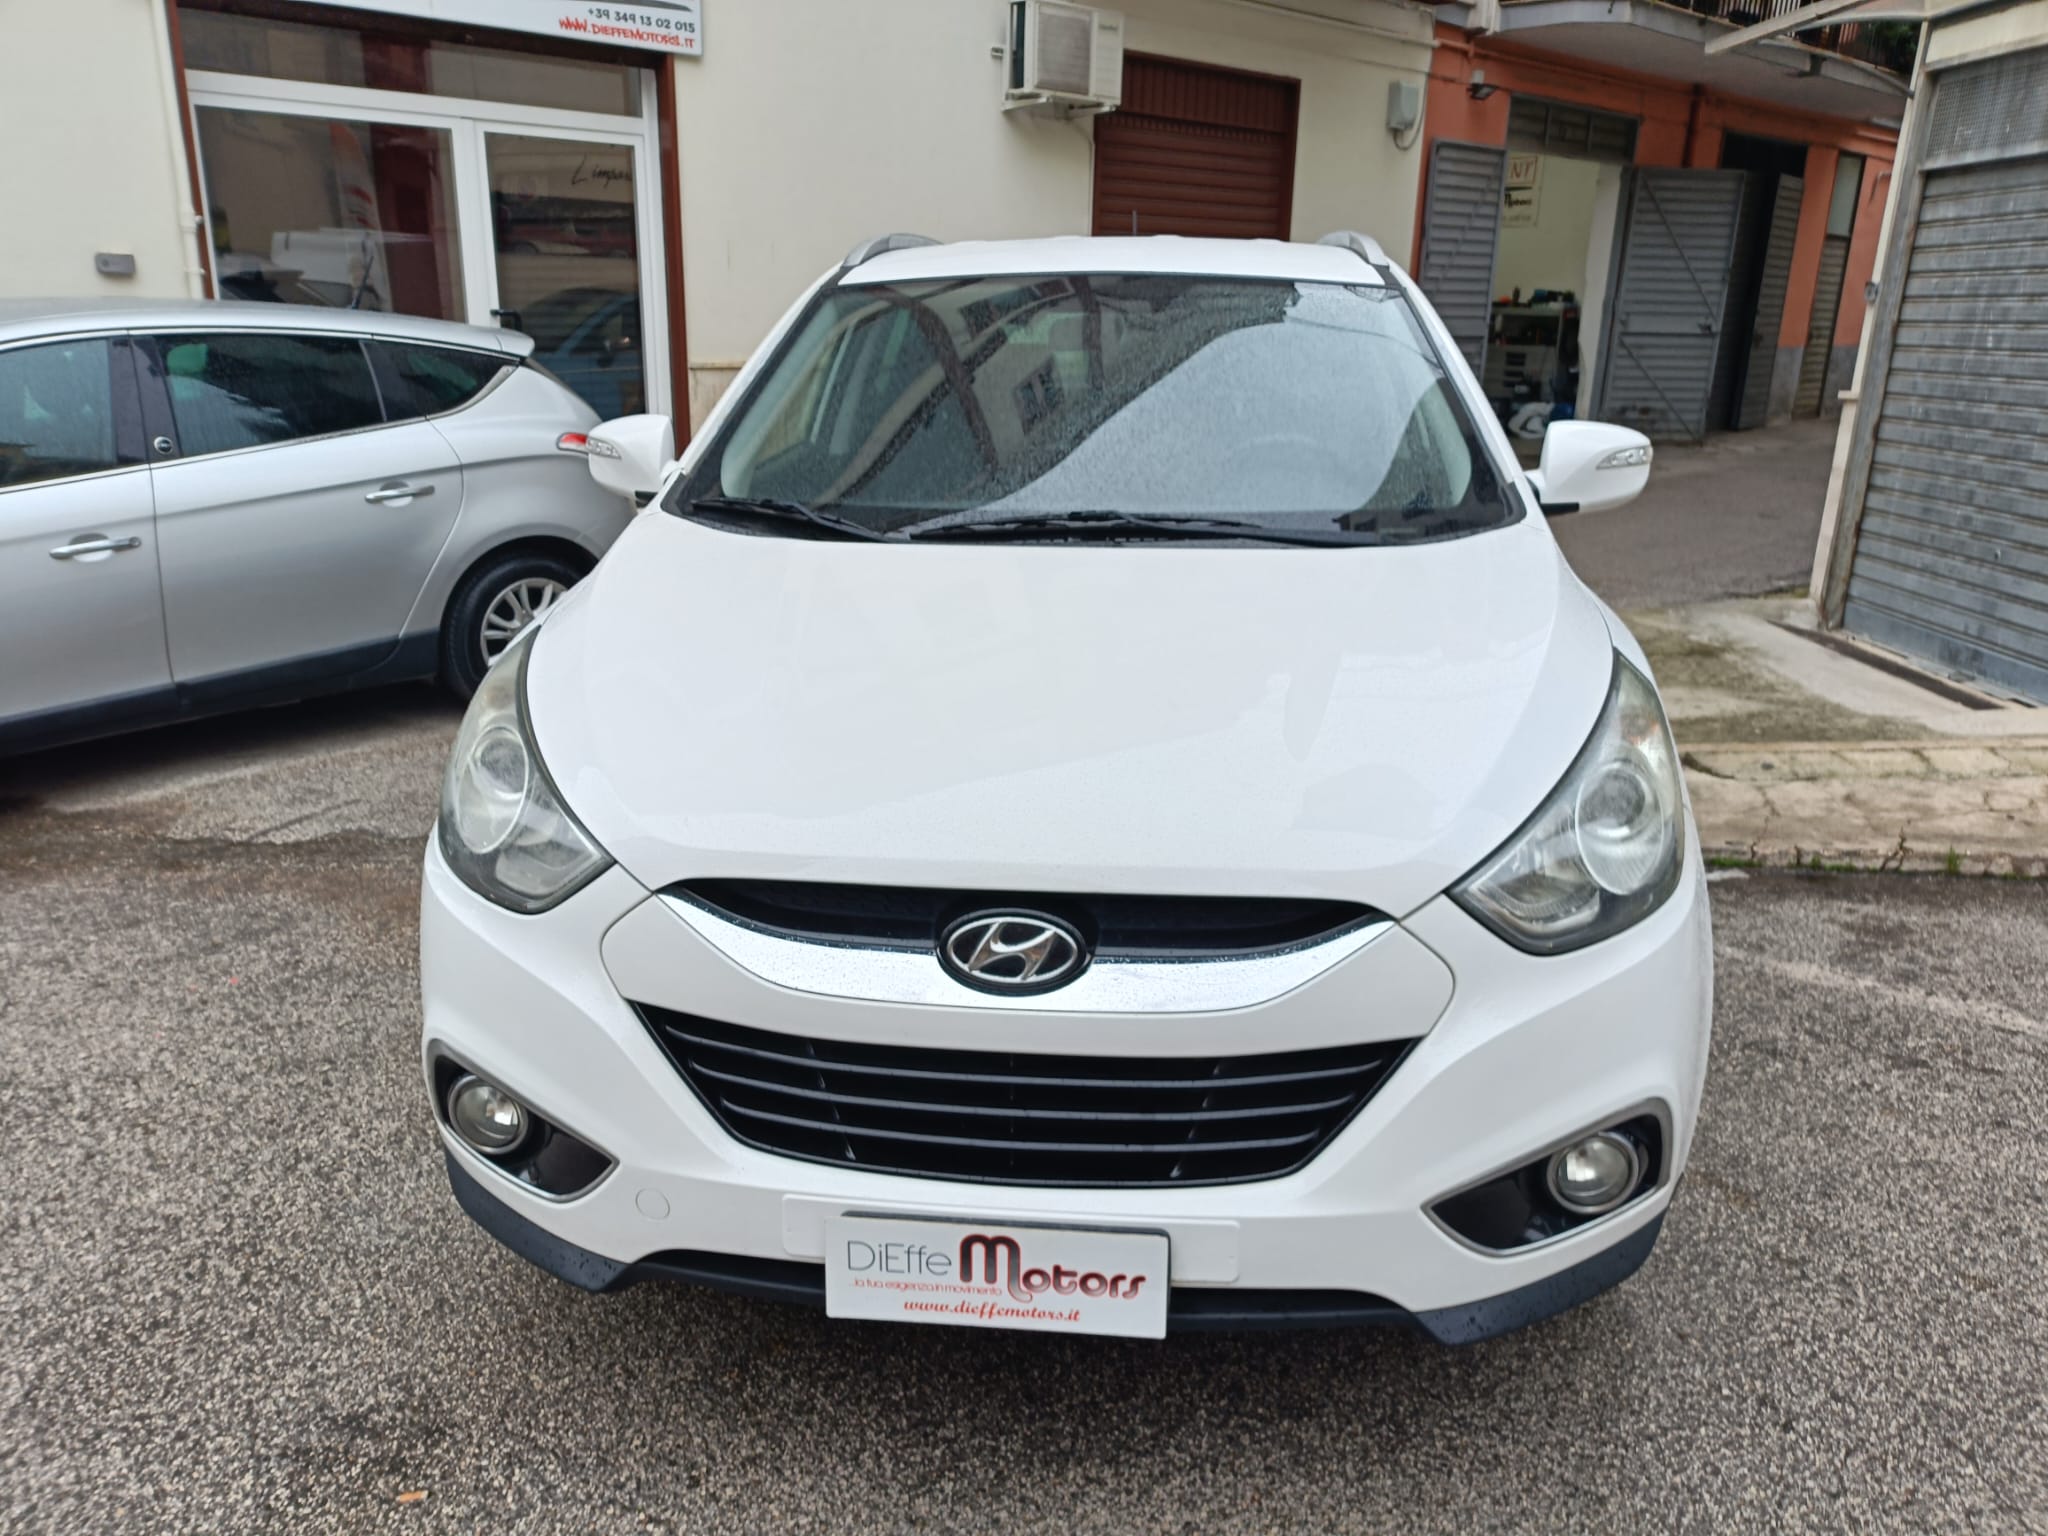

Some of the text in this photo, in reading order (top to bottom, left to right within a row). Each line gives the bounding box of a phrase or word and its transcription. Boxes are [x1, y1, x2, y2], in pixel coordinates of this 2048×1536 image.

[588, 8, 695, 33] +39 349 13 02 015
[847, 1234, 1146, 1303] DiEffe Motors
[885, 1280, 934, 1292] esigenza
[945, 1283, 1002, 1297] movimento
[903, 1299, 1081, 1322] www.dieffemotors.it
